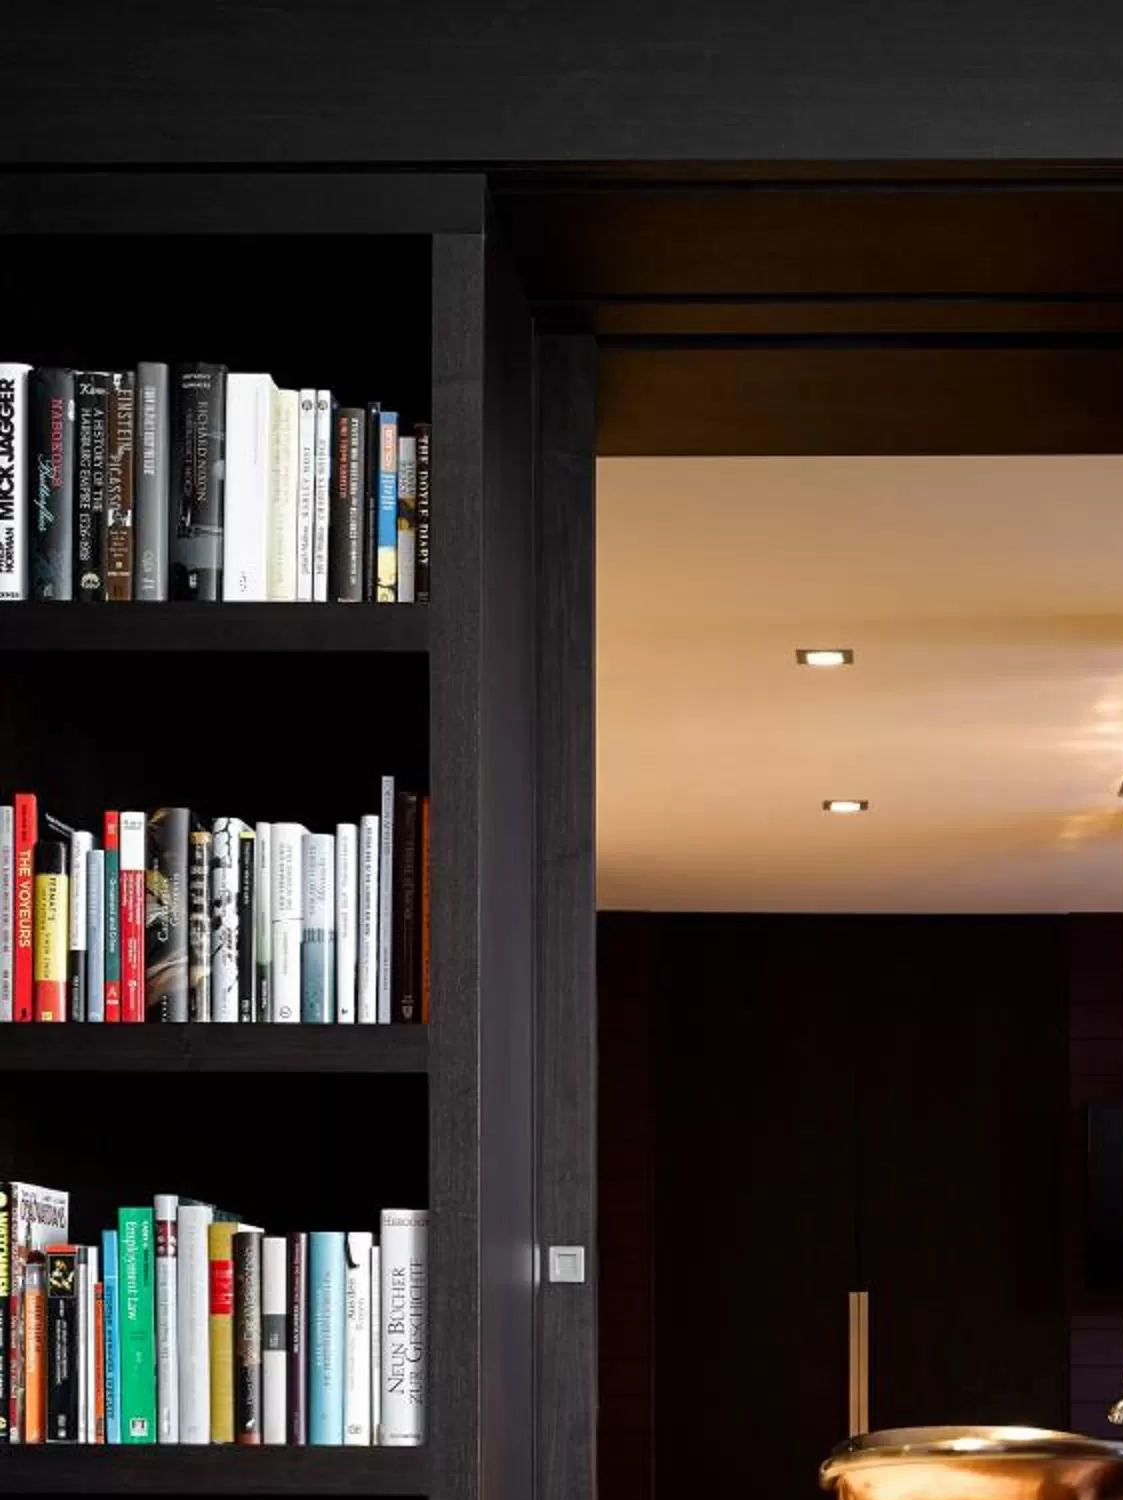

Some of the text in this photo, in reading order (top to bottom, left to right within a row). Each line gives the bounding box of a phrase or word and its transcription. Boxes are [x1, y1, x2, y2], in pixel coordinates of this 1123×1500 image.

[0, 378, 15, 521] MICK JAGGER
[418, 436, 429, 566] THE DOYLE DIARY
[19, 849, 32, 877] THE
[19, 881, 32, 948] VOYEURS
[120, 1221, 139, 1320] Employment Law
[405, 1259, 424, 1363] GESCHICHTE
[387, 1343, 405, 1394] NEUN
